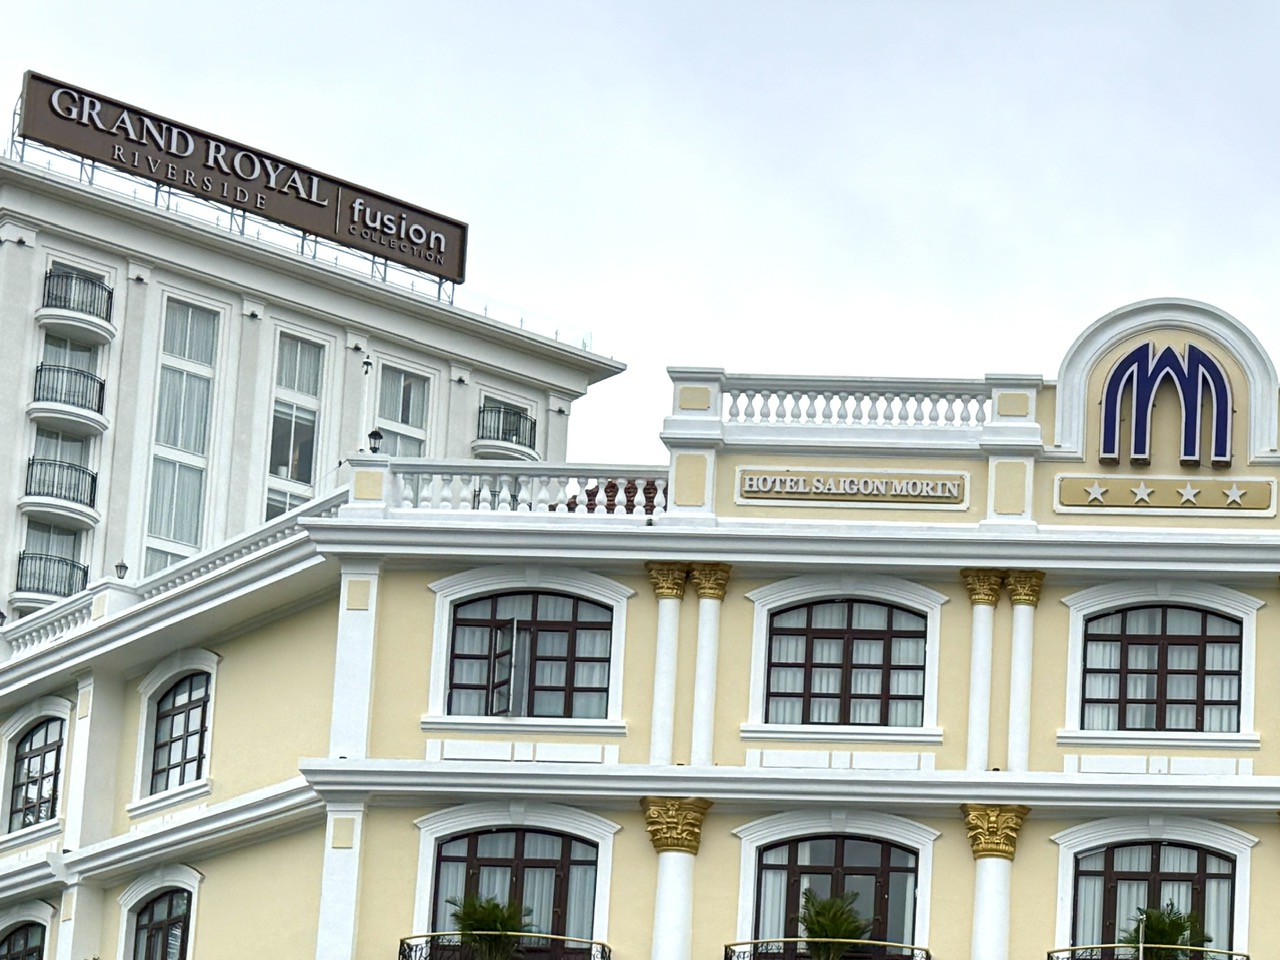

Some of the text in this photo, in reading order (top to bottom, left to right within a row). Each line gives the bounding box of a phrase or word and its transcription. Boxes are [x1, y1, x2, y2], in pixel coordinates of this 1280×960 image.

[51, 87, 329, 206] GRAND ROYAL
[112, 144, 267, 210] RIVERSIDE
[349, 225, 445, 265] COLLECTION
[352, 198, 446, 253] fusion
[744, 475, 960, 498] HOTEL SAIGON MORIN
